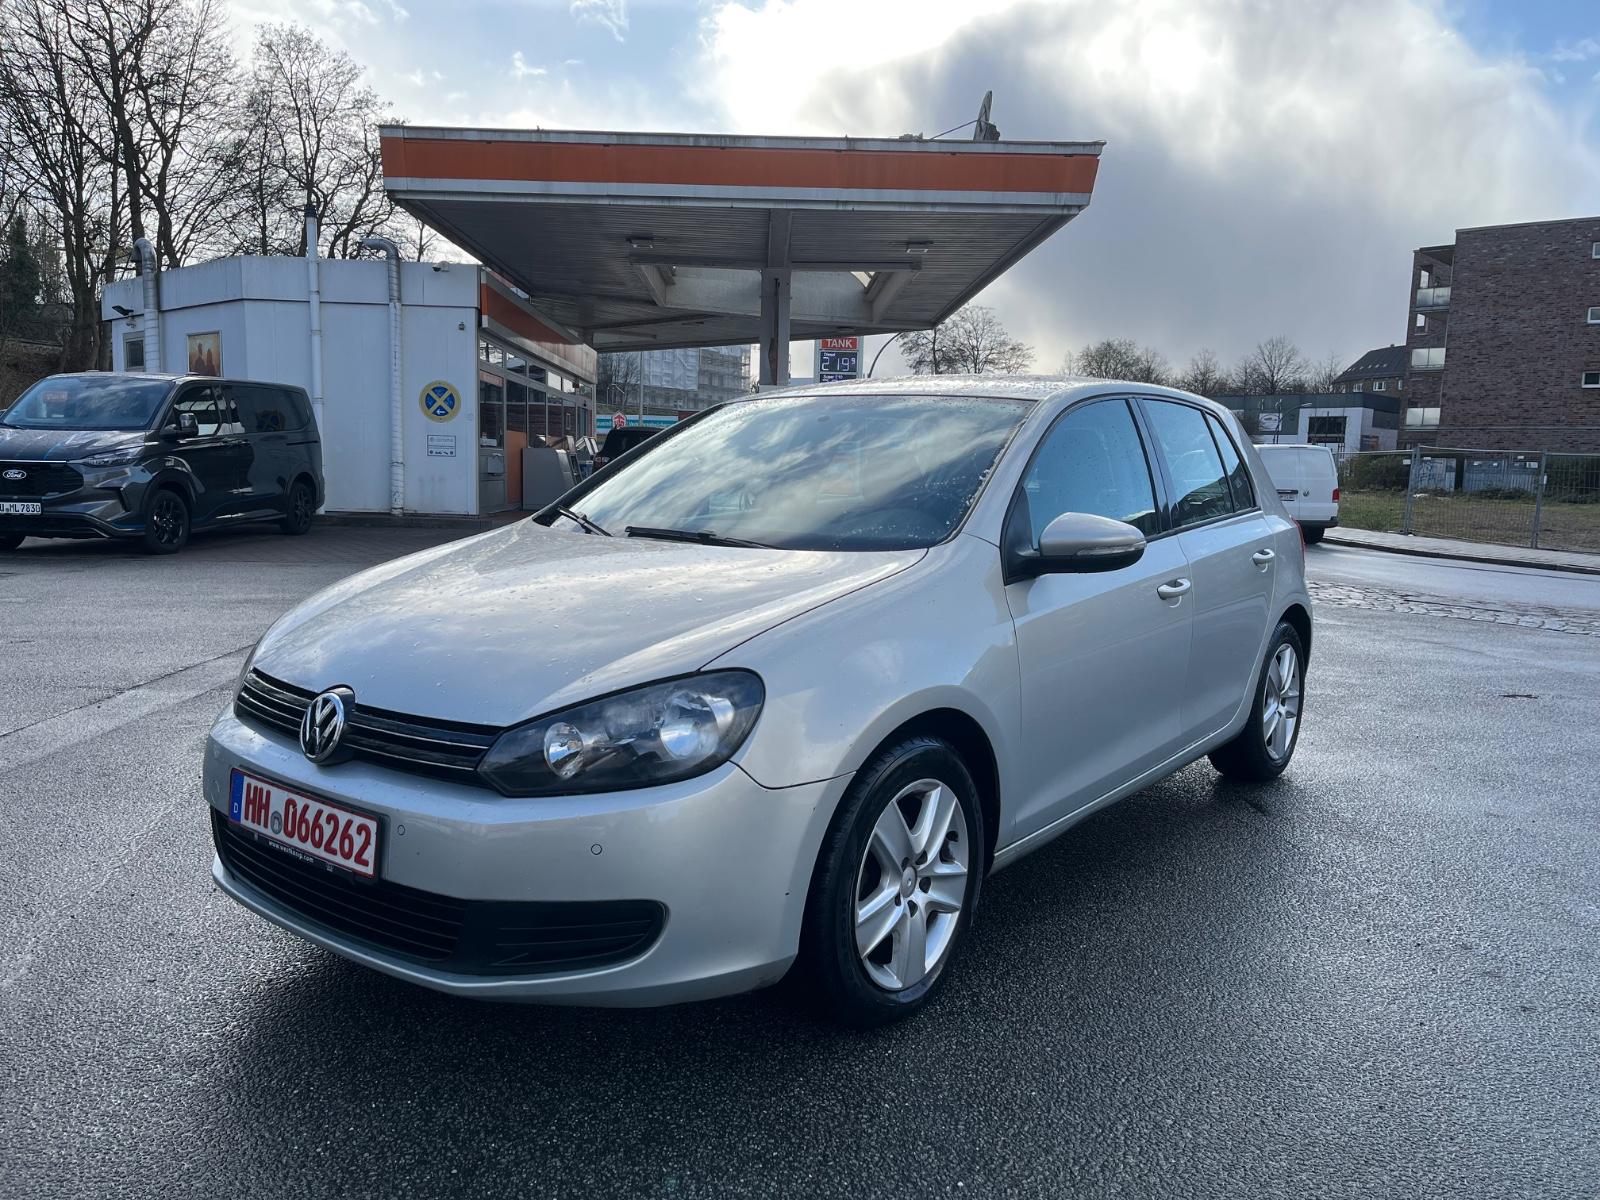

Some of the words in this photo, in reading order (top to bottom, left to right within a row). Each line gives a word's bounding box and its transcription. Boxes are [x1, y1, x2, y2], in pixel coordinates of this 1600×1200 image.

[826, 339, 852, 348] TANK
[10, 504, 20, 512] ML
[20, 504, 40, 512] 7830
[233, 803, 239, 813] D
[244, 782, 272, 829] HH
[283, 797, 372, 868] 066262
